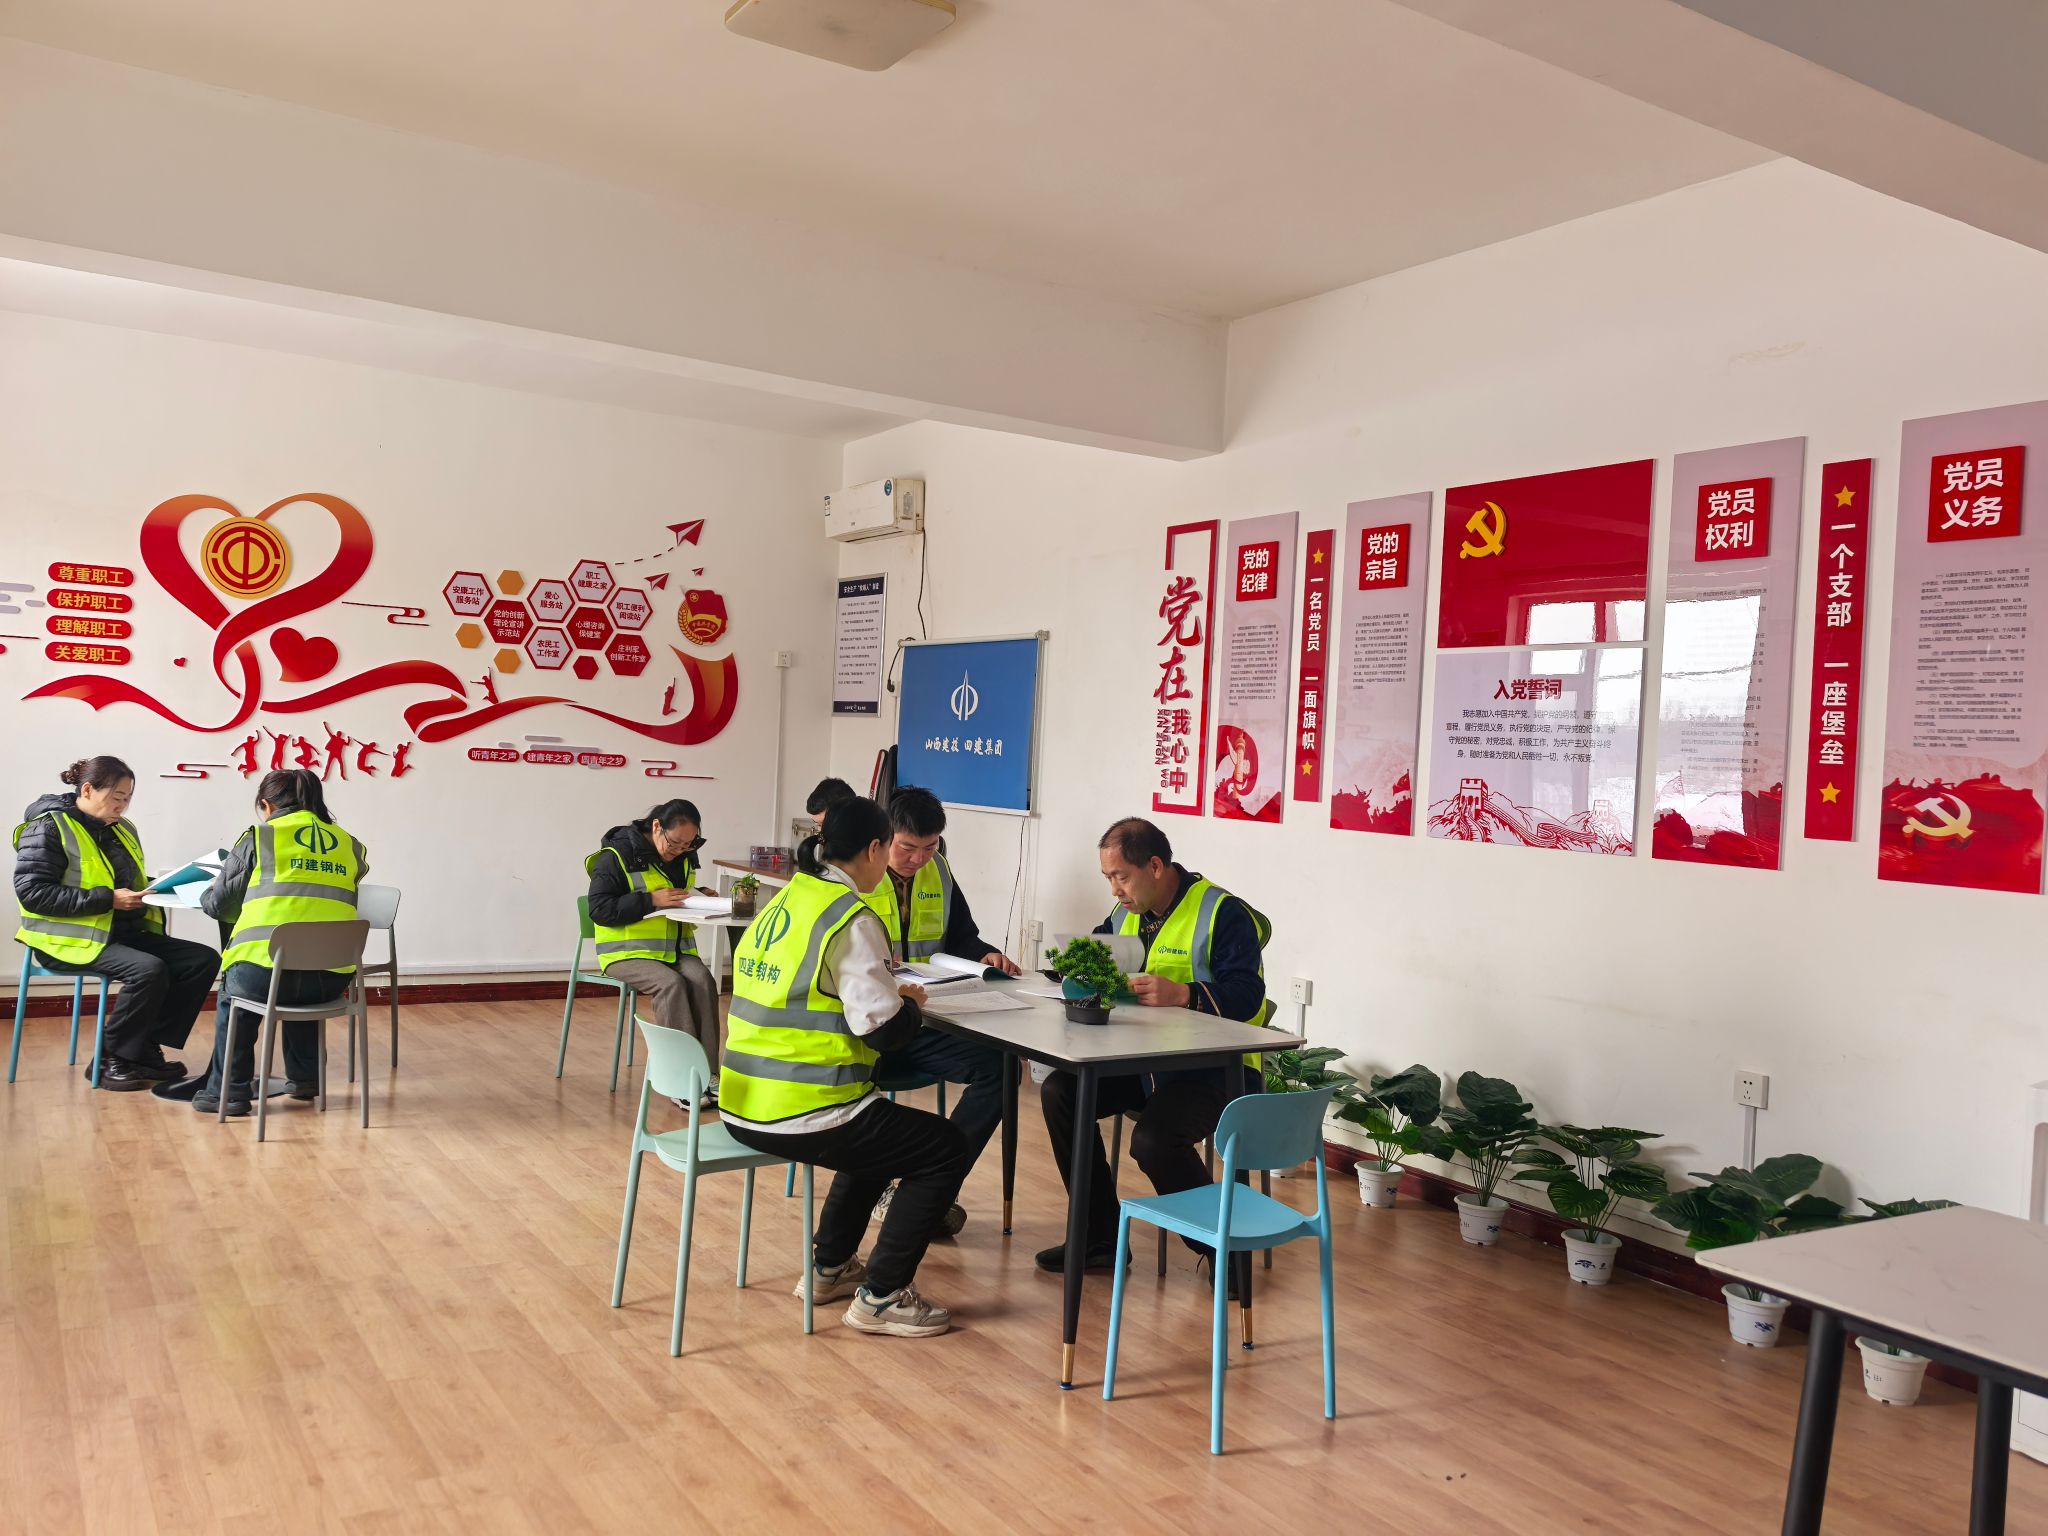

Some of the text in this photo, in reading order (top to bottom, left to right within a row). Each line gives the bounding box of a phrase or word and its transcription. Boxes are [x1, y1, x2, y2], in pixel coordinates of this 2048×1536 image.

[1942, 457, 2004, 494] 党员
[1706, 487, 1755, 518] 党员
[1940, 495, 2003, 531] 义务
[1366, 532, 1399, 556] 党的
[1705, 519, 1754, 551] 权利
[1242, 549, 1269, 570] 党的
[58, 565, 125, 584] 尊重职工
[585, 571, 600, 579] 职工
[1365, 558, 1398, 582] 宗旨
[452, 586, 484, 596] 安康工作
[578, 579, 608, 590] 健康之家
[1240, 572, 1268, 594] 纪律
[56, 591, 123, 610] 保护职工
[455, 595, 480, 605] 服务站
[540, 600, 563, 609] 服务站
[544, 591, 560, 600] 爱心
[493, 609, 525, 619] 党的创新
[55, 618, 122, 636] 理解职工
[492, 619, 524, 629] 理论宣讲
[497, 629, 520, 638] 示范站
[537, 640, 560, 649] 农民工
[1818, 523, 1856, 765] 一个支部 一座堡垒
[55, 645, 122, 662] 关爱职工
[536, 649, 560, 658] 工作室
[1301, 577, 1324, 751] 一名党员 一面旗帜
[1493, 678, 1563, 701] 入党誓词
[471, 750, 517, 760] 听青年之声
[527, 753, 572, 763] 建青年之家
[1169, 708, 1192, 794] 我心中
[290, 858, 346, 876] 四建钢构
[739, 957, 781, 985] 四建钢构
